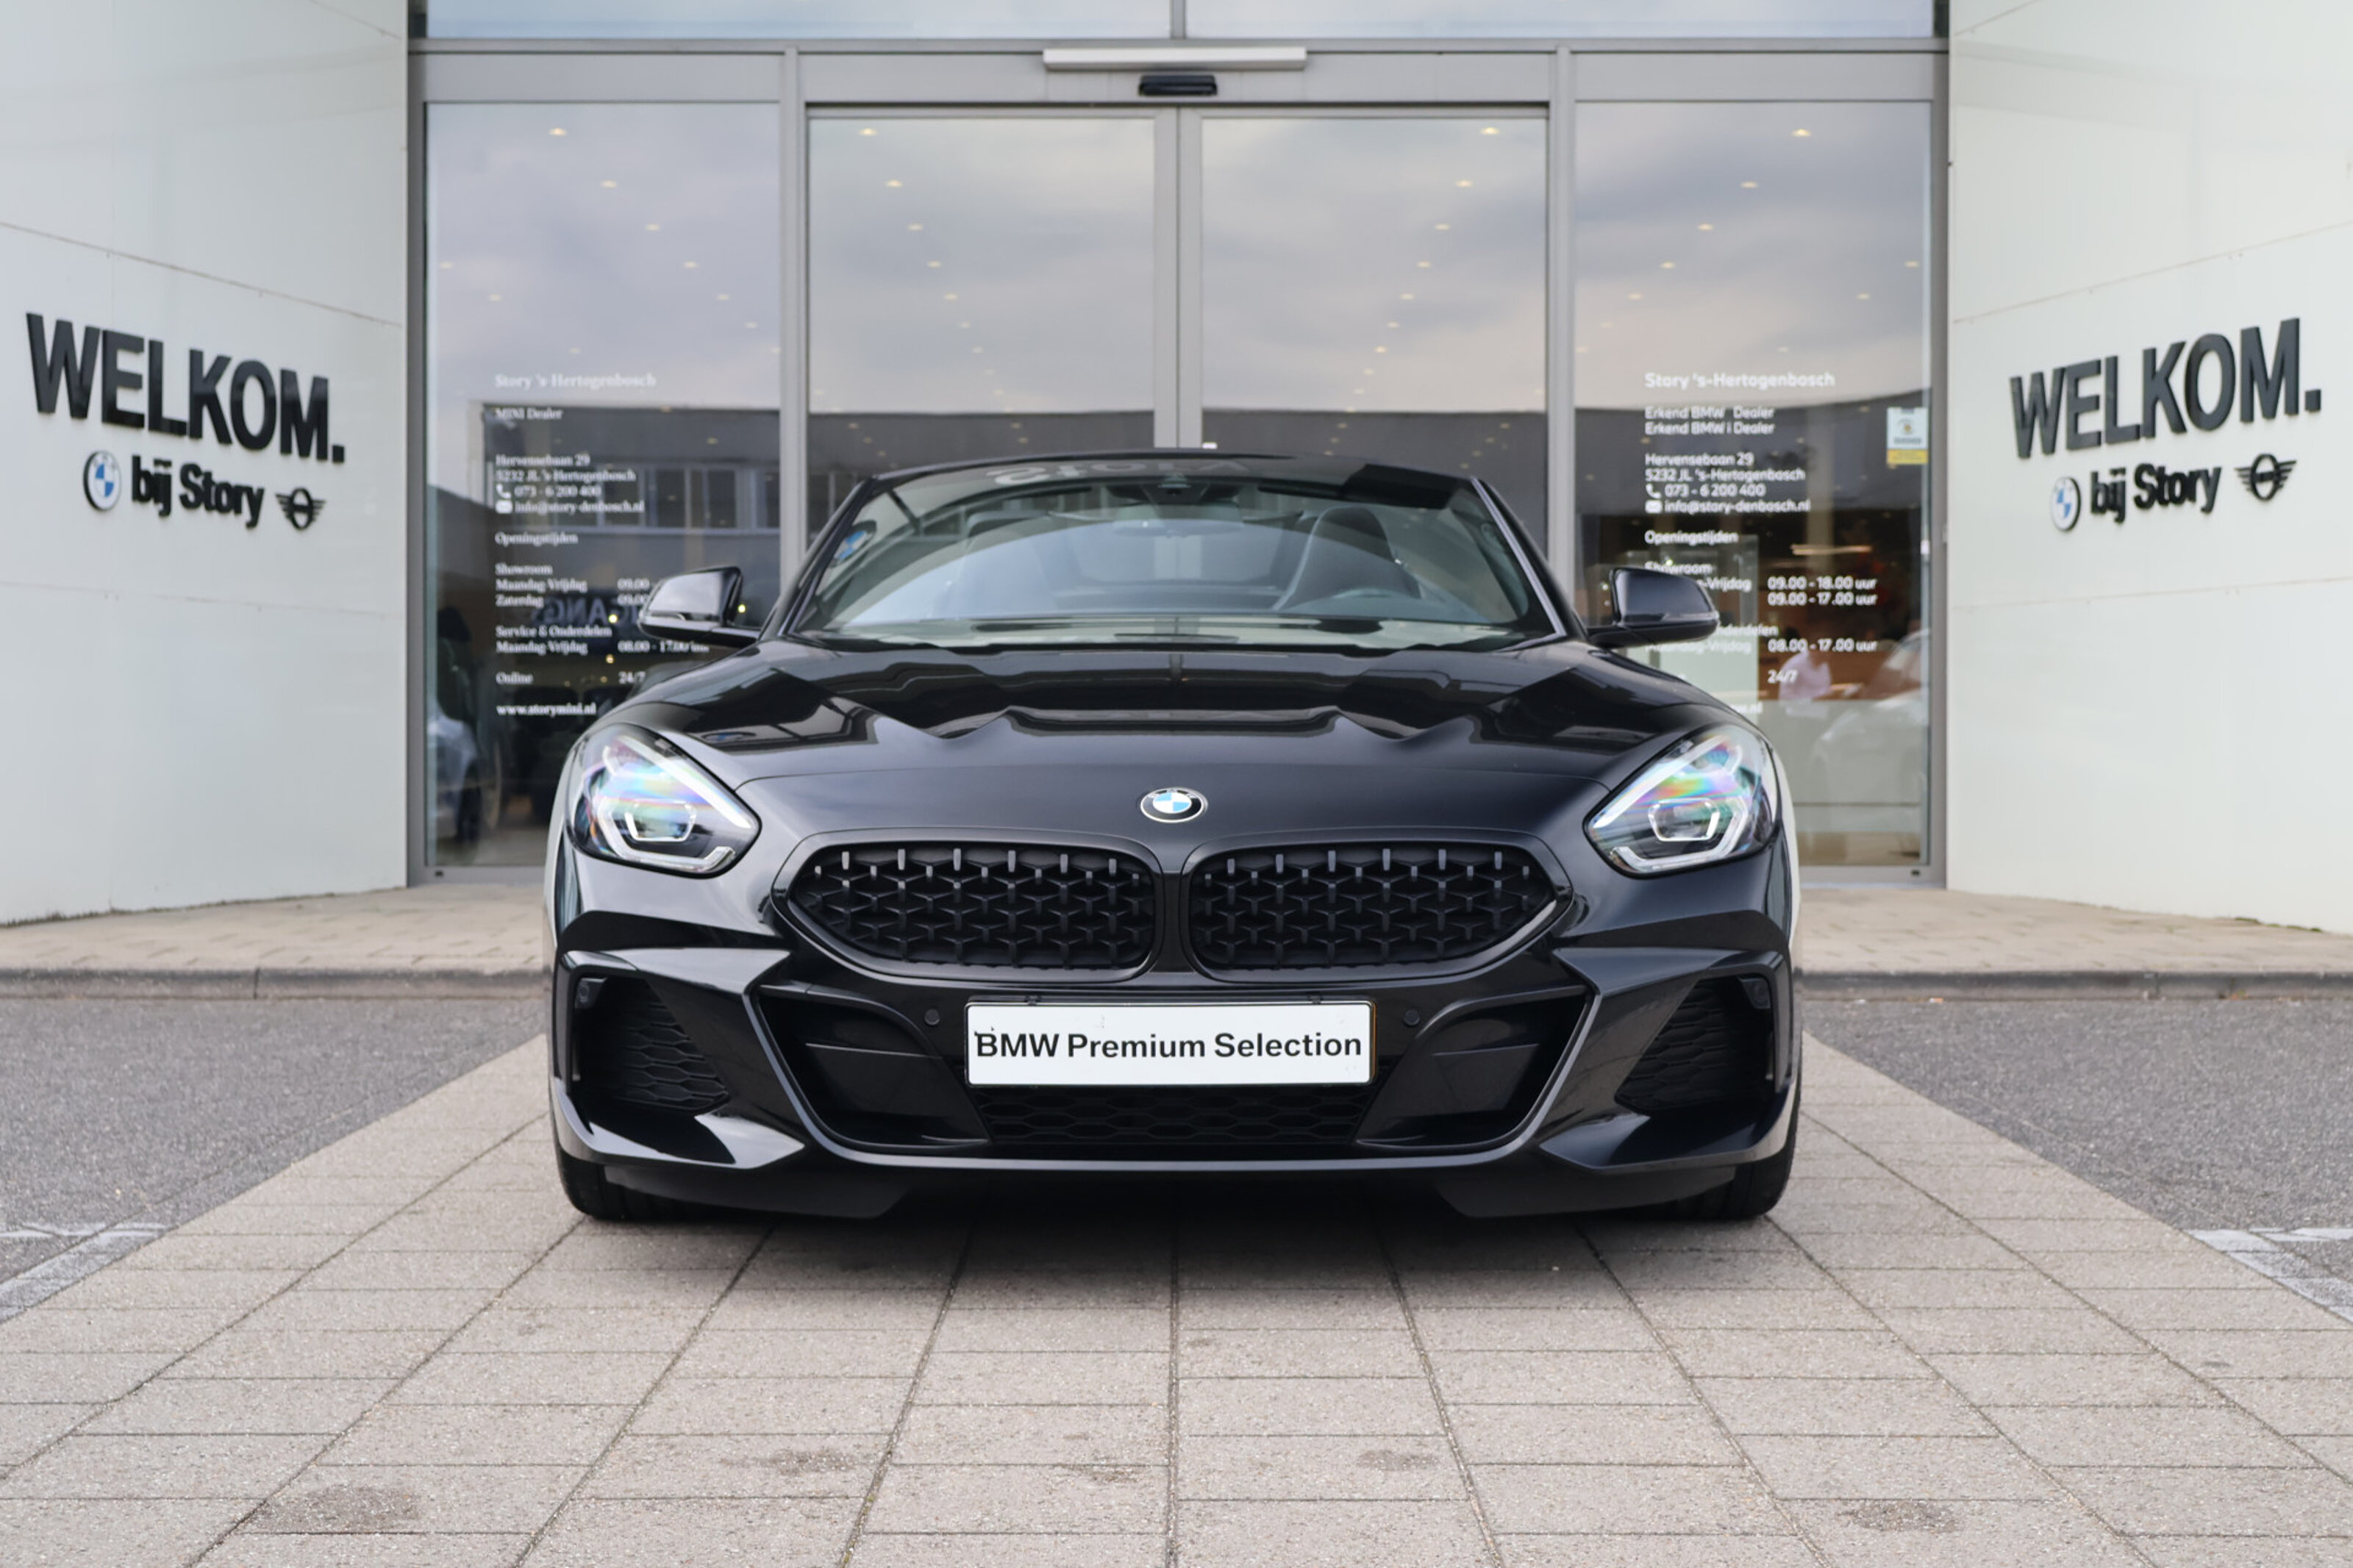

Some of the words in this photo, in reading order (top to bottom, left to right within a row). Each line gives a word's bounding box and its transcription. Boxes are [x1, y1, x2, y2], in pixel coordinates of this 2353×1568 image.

[26, 312, 345, 463] WELKOM.
[495, 373, 531, 390] Story
[1644, 373, 1689, 390] Story
[1692, 372, 1836, 390] 's-Hertogenbosch
[2010, 318, 2321, 459] WELKOM.
[1644, 407, 1689, 420] Erkend
[1690, 407, 1725, 420] BMW
[1733, 406, 1774, 420] Dealer
[1644, 422, 1689, 435] Erkend
[1690, 422, 1726, 435] BMW
[1733, 421, 1775, 435] Dealer
[574, 453, 590, 467] 29
[1645, 453, 1735, 466] Hervensebaan
[1736, 452, 1754, 466] 29
[1645, 468, 1677, 482] 5232
[132, 455, 172, 518] bij
[179, 462, 265, 529] Story
[556, 485, 578, 498] 200
[579, 485, 602, 498] 400
[1665, 484, 1690, 497] 073
[1699, 484, 1710, 497] 6
[1710, 484, 1738, 497] 200
[1739, 484, 1766, 497] 400
[2090, 467, 2127, 523] bij
[2133, 463, 2222, 514] Story
[1664, 498, 1811, 515] info@story-denbosch.nl
[495, 531, 579, 547] Openingstijden
[1644, 529, 1739, 545] Openingstijden
[495, 562, 552, 575] Showroom
[1768, 576, 1807, 590] 09.00
[1816, 576, 1854, 590] 18.00
[1854, 579, 1877, 590] uur
[496, 594, 545, 608] Zaterdag
[1768, 592, 1807, 606] 09.00
[1855, 595, 1877, 606] uur
[496, 626, 537, 637] Service
[538, 626, 548, 637] &
[549, 625, 612, 637] Onderdelen
[1768, 639, 1808, 653] 08.00
[1856, 642, 1877, 653] uur
[496, 671, 533, 684] Online
[618, 670, 646, 684] 24/7
[1768, 670, 1799, 684] 24/7
[496, 702, 596, 718] www.storymini.nl
[975, 1032, 1059, 1057] BMW
[1068, 1032, 1205, 1058] Premium
[1214, 1032, 1361, 1057] Selection
